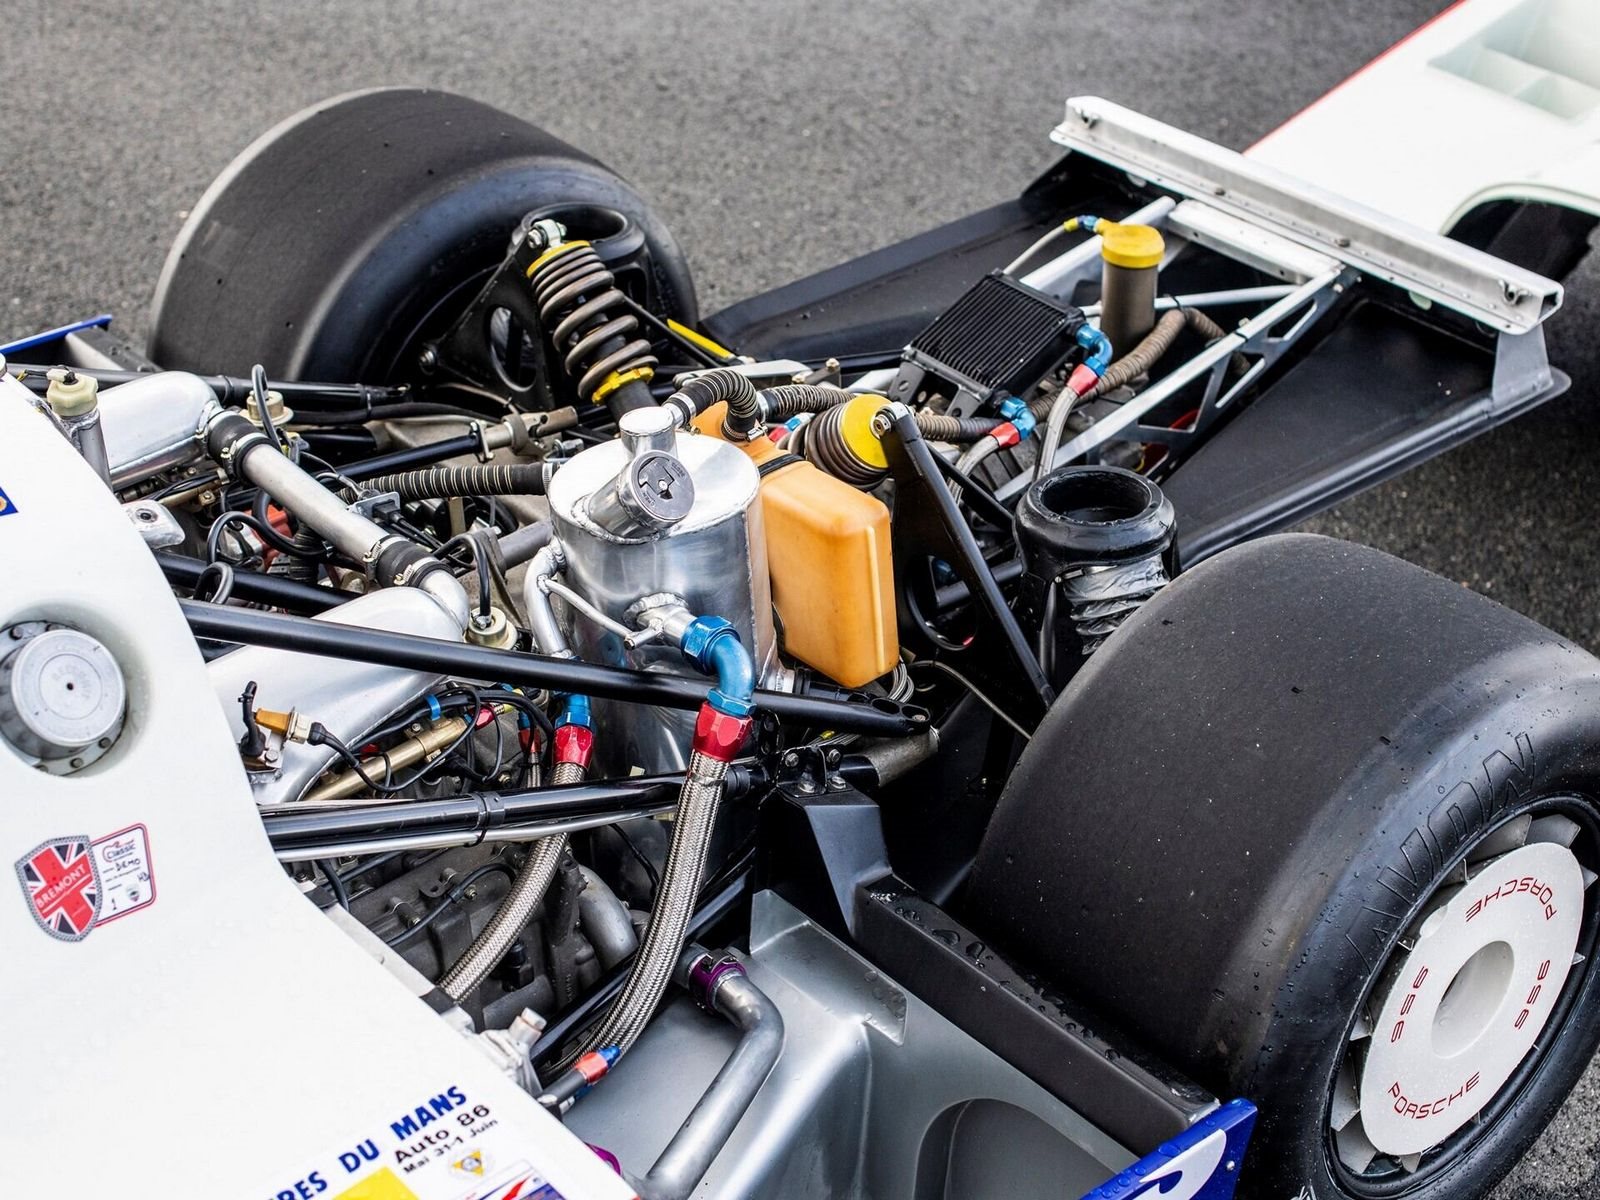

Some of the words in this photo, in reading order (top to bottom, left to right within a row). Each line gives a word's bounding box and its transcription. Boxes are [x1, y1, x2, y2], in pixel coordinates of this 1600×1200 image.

[36, 864, 87, 909] BREMONT
[1465, 877, 1557, 922] PORSCHE
[1391, 965, 1429, 1043] 956
[1514, 959, 1550, 1030] 956
[1388, 1072, 1480, 1120] PORSCHE
[338, 1139, 380, 1173] DU
[390, 1086, 467, 1140] MANS
[395, 1130, 449, 1164] Auto
[456, 1104, 490, 1127] 86
[403, 1156, 430, 1173] Mai
[470, 1119, 498, 1138] Juin
